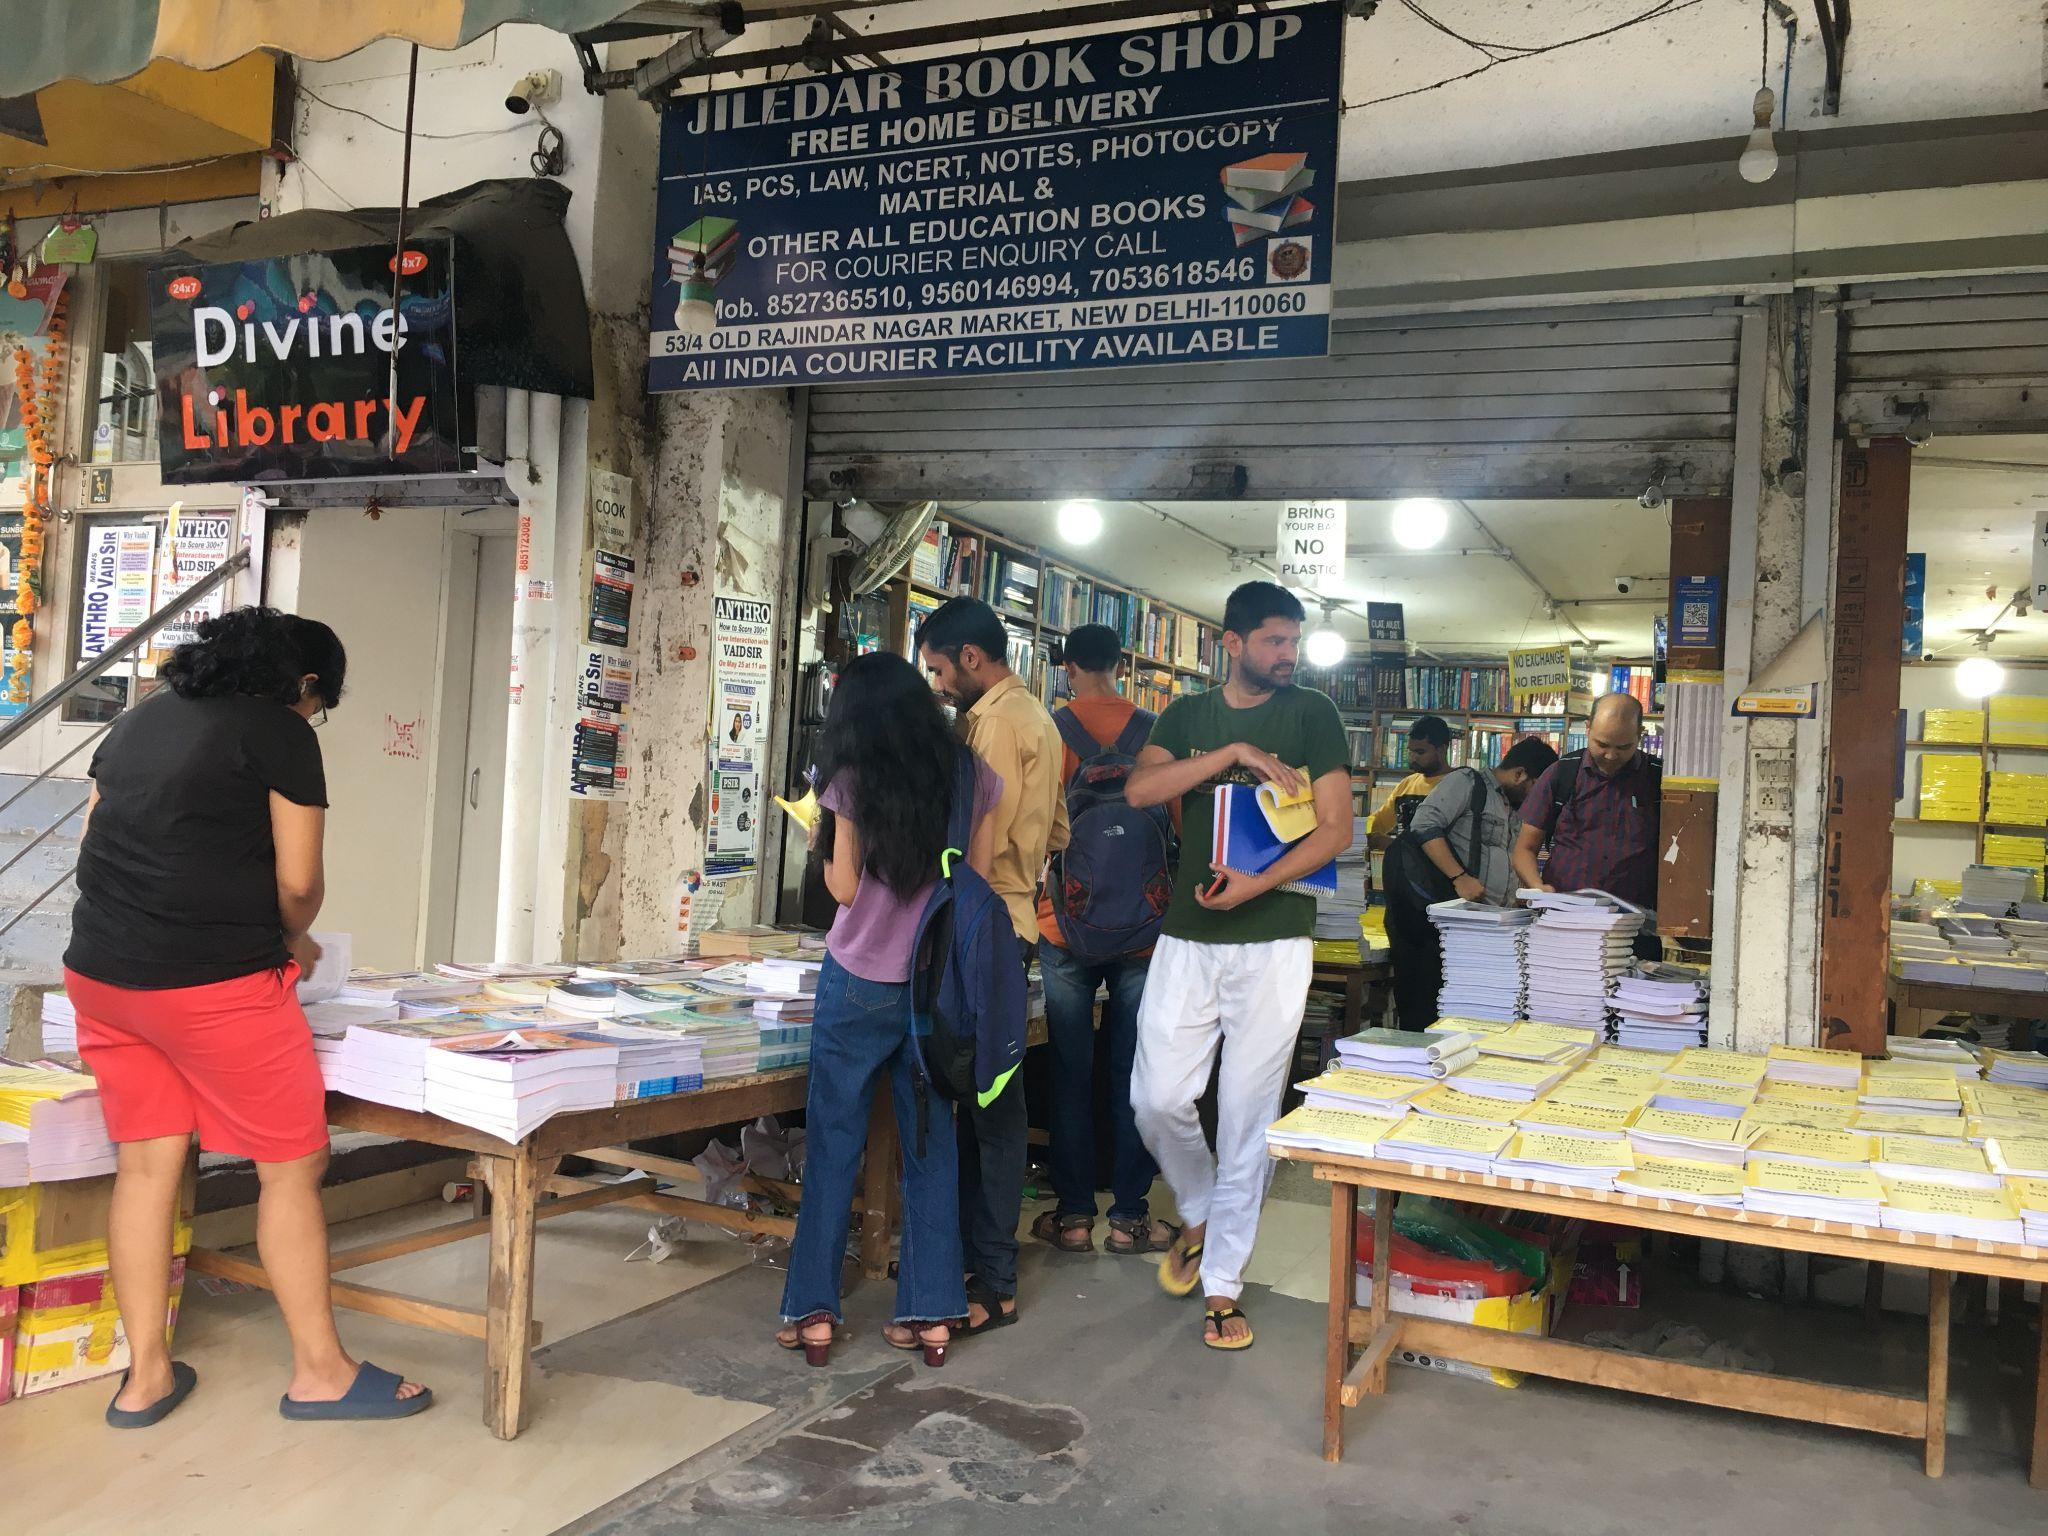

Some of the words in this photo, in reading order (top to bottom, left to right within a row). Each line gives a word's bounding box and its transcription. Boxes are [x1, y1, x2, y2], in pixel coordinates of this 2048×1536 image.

[687, 72, 902, 135] JILEDAR
[925, 43, 1096, 104] BOOK
[1118, 14, 1302, 78] SHOP
[790, 123, 869, 157] FREE
[880, 110, 975, 146] HOME
[988, 85, 1163, 134] DELIVERY
[693, 180, 737, 205] IAS,
[746, 174, 800, 199] PCS,
[809, 166, 868, 193] LAW,
[878, 154, 970, 185] NCERT,
[980, 142, 1081, 175] NOTES,
[1092, 117, 1283, 162] PHOTOCOPY
[880, 180, 1024, 216] MATERIAL
[1034, 176, 1055, 200] &
[748, 230, 839, 258] OTHER
[847, 225, 899, 250] ALL
[909, 207, 1079, 244] EDUCATION
[1091, 194, 1206, 227] BOOKS
[395, 257, 422, 268] 4x7
[776, 261, 826, 284] FOR
[835, 250, 953, 280] COURIER
[962, 237, 1087, 271] ENQUIRY
[1095, 230, 1166, 258] CALL
[173, 282, 197, 294] 24x7
[767, 286, 912, 315] 8527365510,
[922, 272, 1079, 305] 9560146994,
[1090, 257, 1254, 293] 7053618546
[194, 297, 409, 368] Divine
[665, 334, 703, 353] 53/4
[709, 330, 751, 350] OLD
[758, 323, 866, 347] RAJINDAR
[873, 317, 953, 340] NAGAR
[961, 309, 1063, 334] MARKET,
[1071, 304, 1128, 326] NEW
[1135, 292, 1306, 322] DELHI-110060
[724, 355, 798, 379] INDIA
[806, 347, 937, 375] COURIER
[947, 337, 1085, 369] FACILITY
[1091, 325, 1279, 360] AVAILABLE
[181, 389, 426, 454] Library
[596, 499, 626, 519] COOK
[1287, 507, 1335, 519] BRING
[1285, 523, 1314, 531] YOUR
[99, 531, 117, 555] SIR
[188, 541, 204, 549] Score
[1295, 539, 1324, 554] NO
[97, 556, 114, 591] VAID
[178, 561, 195, 571] AID
[197, 561, 216, 571] SIR
[1282, 564, 1336, 575] PLASTIC
[85, 591, 108, 653] ANTHRO
[716, 599, 770, 624] ANTHRO
[719, 623, 730, 631] How
[738, 624, 752, 633] Score
[730, 635, 757, 644] Interaction
[724, 645, 746, 657] VAID
[747, 646, 762, 659] SIR
[1514, 655, 1523, 668] NO
[1525, 650, 1565, 667] EXCHANGE
[586, 653, 601, 679] SIR
[1514, 676, 1528, 688] NO
[1530, 673, 1569, 686] RETURN
[723, 778, 739, 789] PSIR
